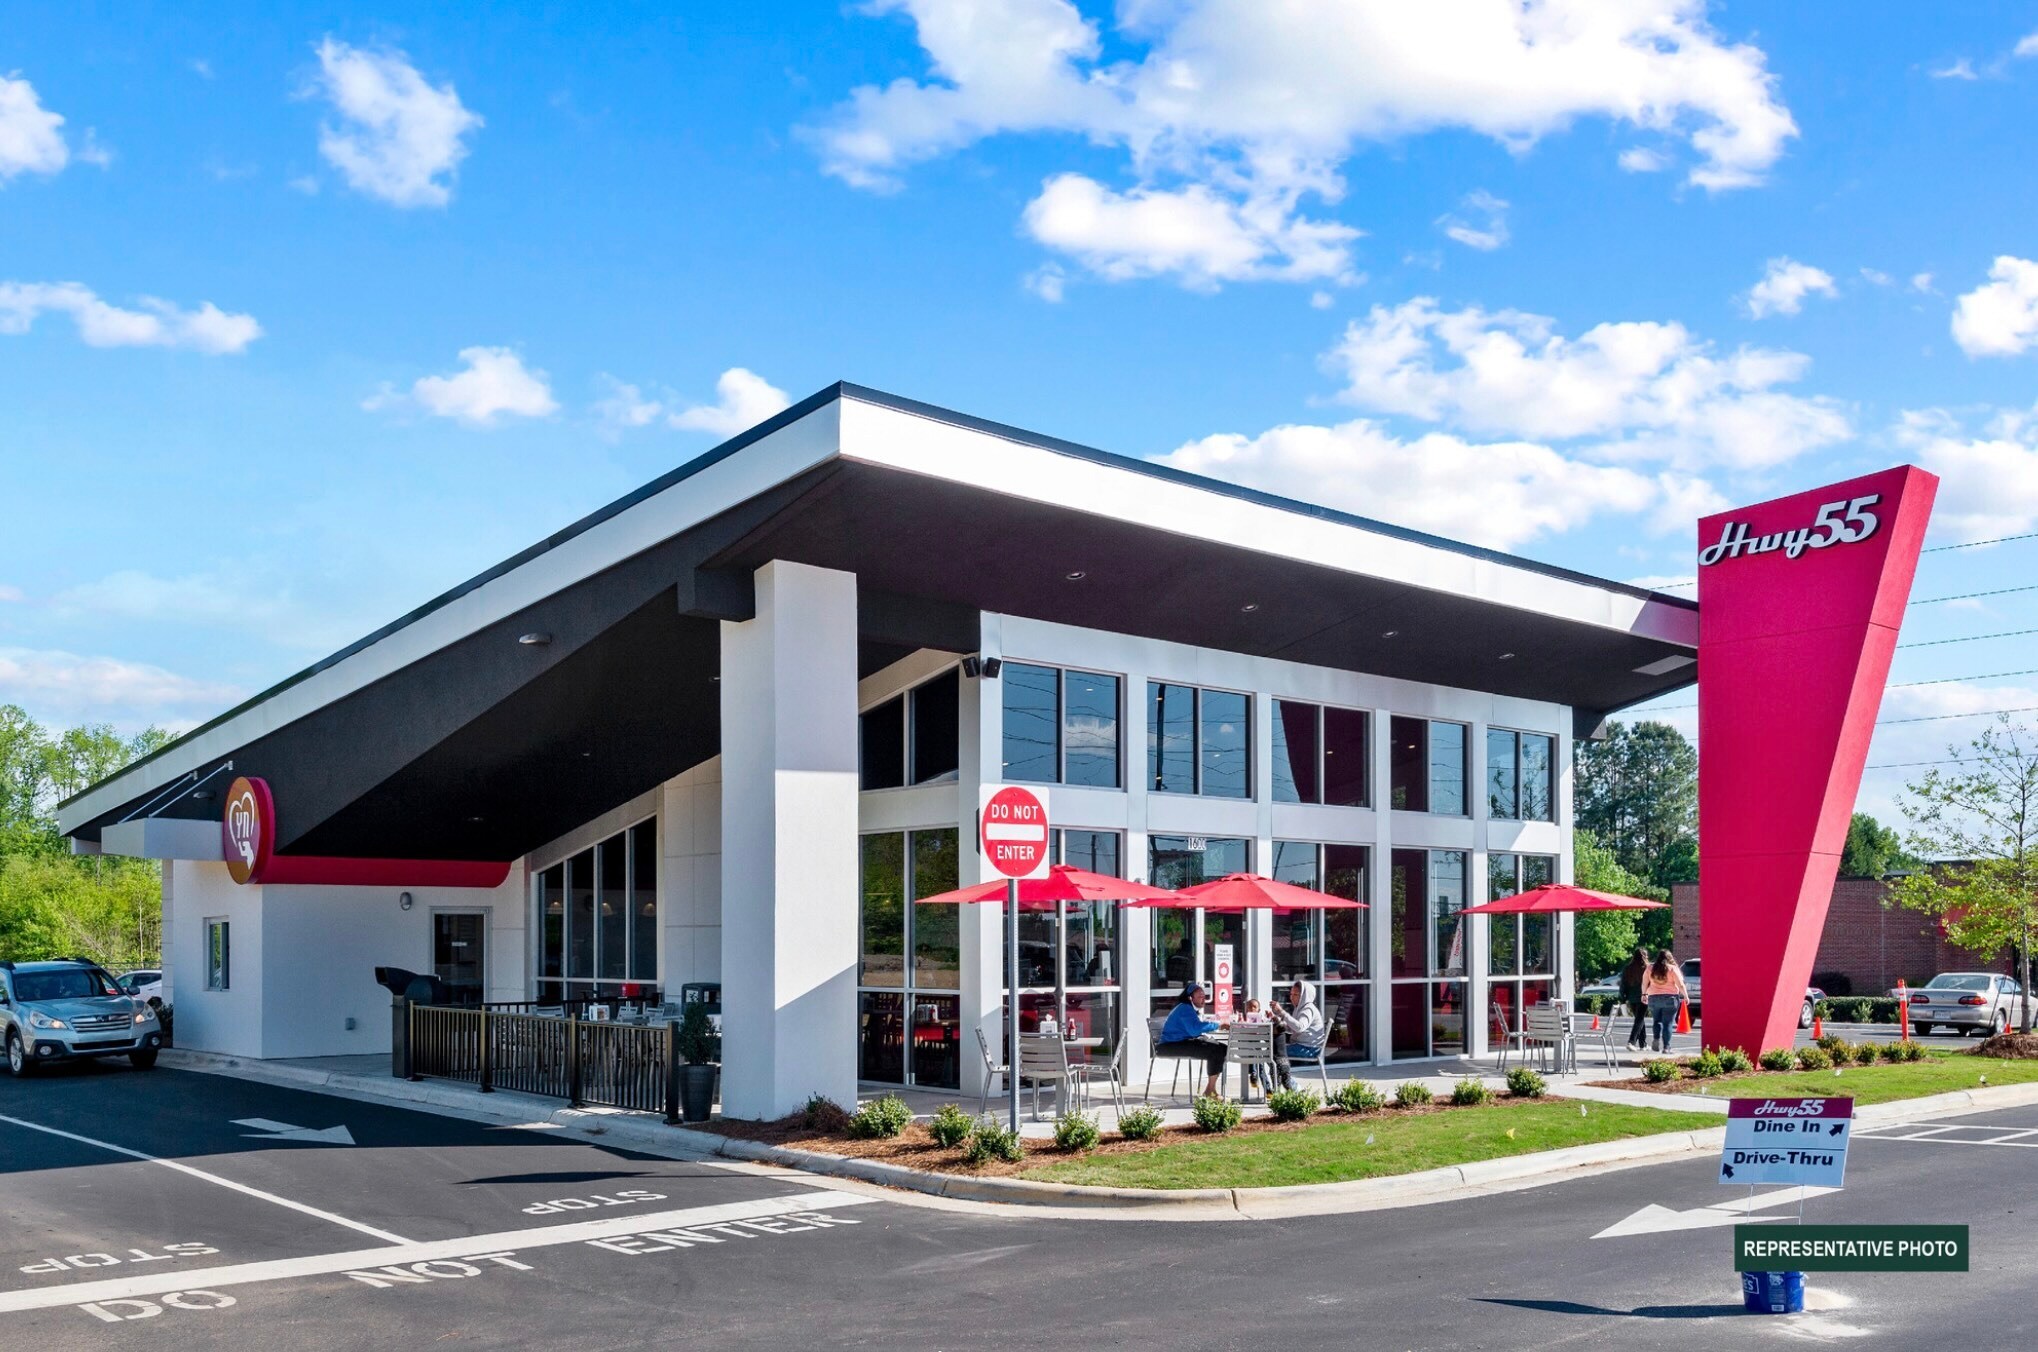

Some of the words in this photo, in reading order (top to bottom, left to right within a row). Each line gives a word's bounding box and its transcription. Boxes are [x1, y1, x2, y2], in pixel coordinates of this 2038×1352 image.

[991, 804, 1009, 819] DO
[1013, 805, 1039, 820] NOT
[997, 845, 1035, 860] ENTER
[1753, 1120, 1795, 1133] Dine
[1801, 1120, 1821, 1133] In
[1733, 1151, 1834, 1166] Drive-Thru
[521, 1190, 668, 1216] STOP
[19, 1242, 221, 1274] STOP
[77, 1290, 237, 1322] DO
[341, 1251, 534, 1288] NOT
[584, 1212, 863, 1255] ENTER
